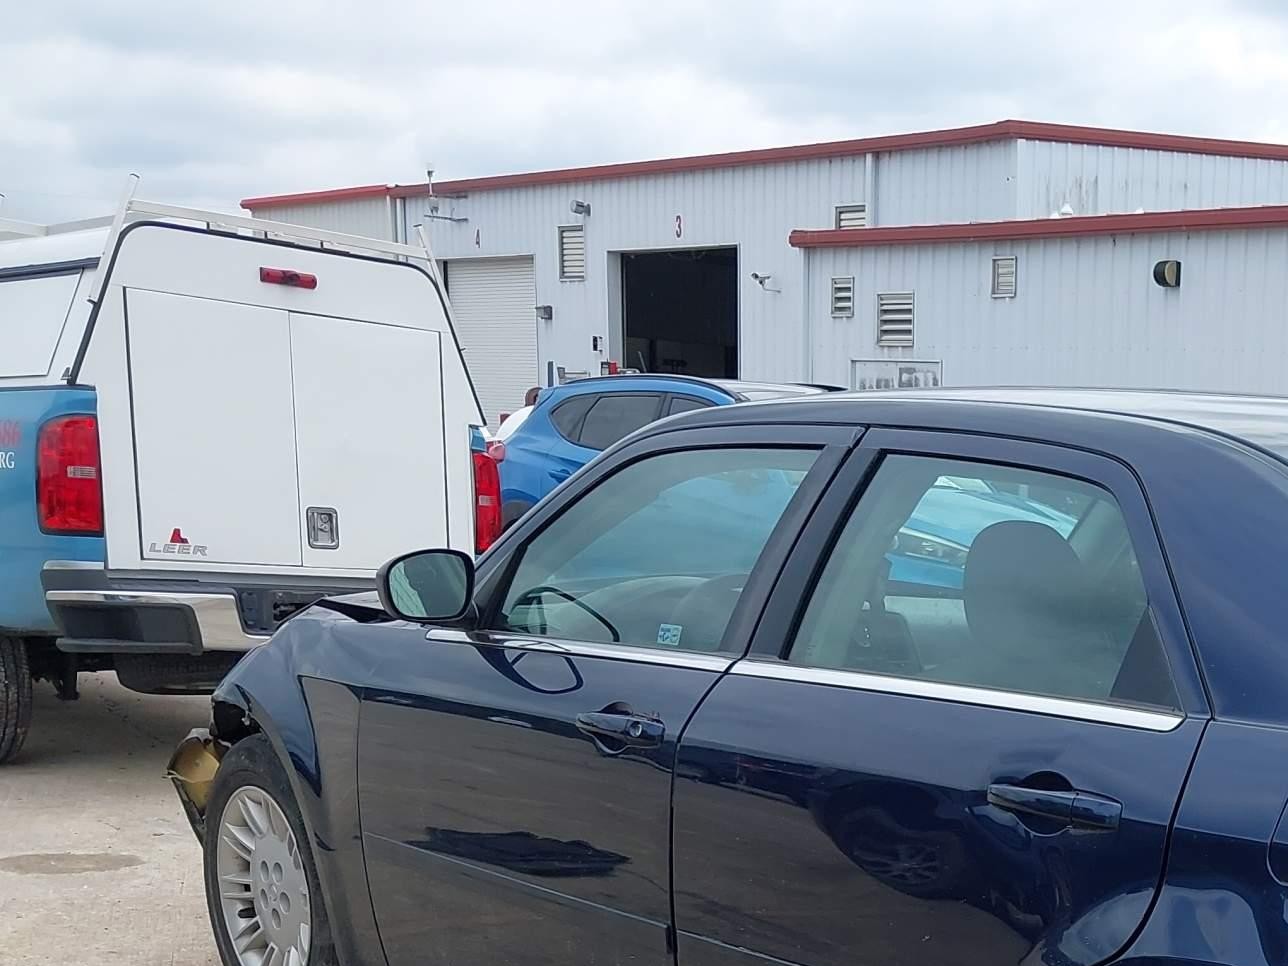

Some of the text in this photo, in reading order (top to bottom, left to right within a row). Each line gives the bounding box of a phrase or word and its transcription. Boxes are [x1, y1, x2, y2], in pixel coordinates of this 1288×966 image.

[675, 214, 682, 239] 3
[475, 228, 481, 249] 4
[148, 542, 208, 556] LEER
